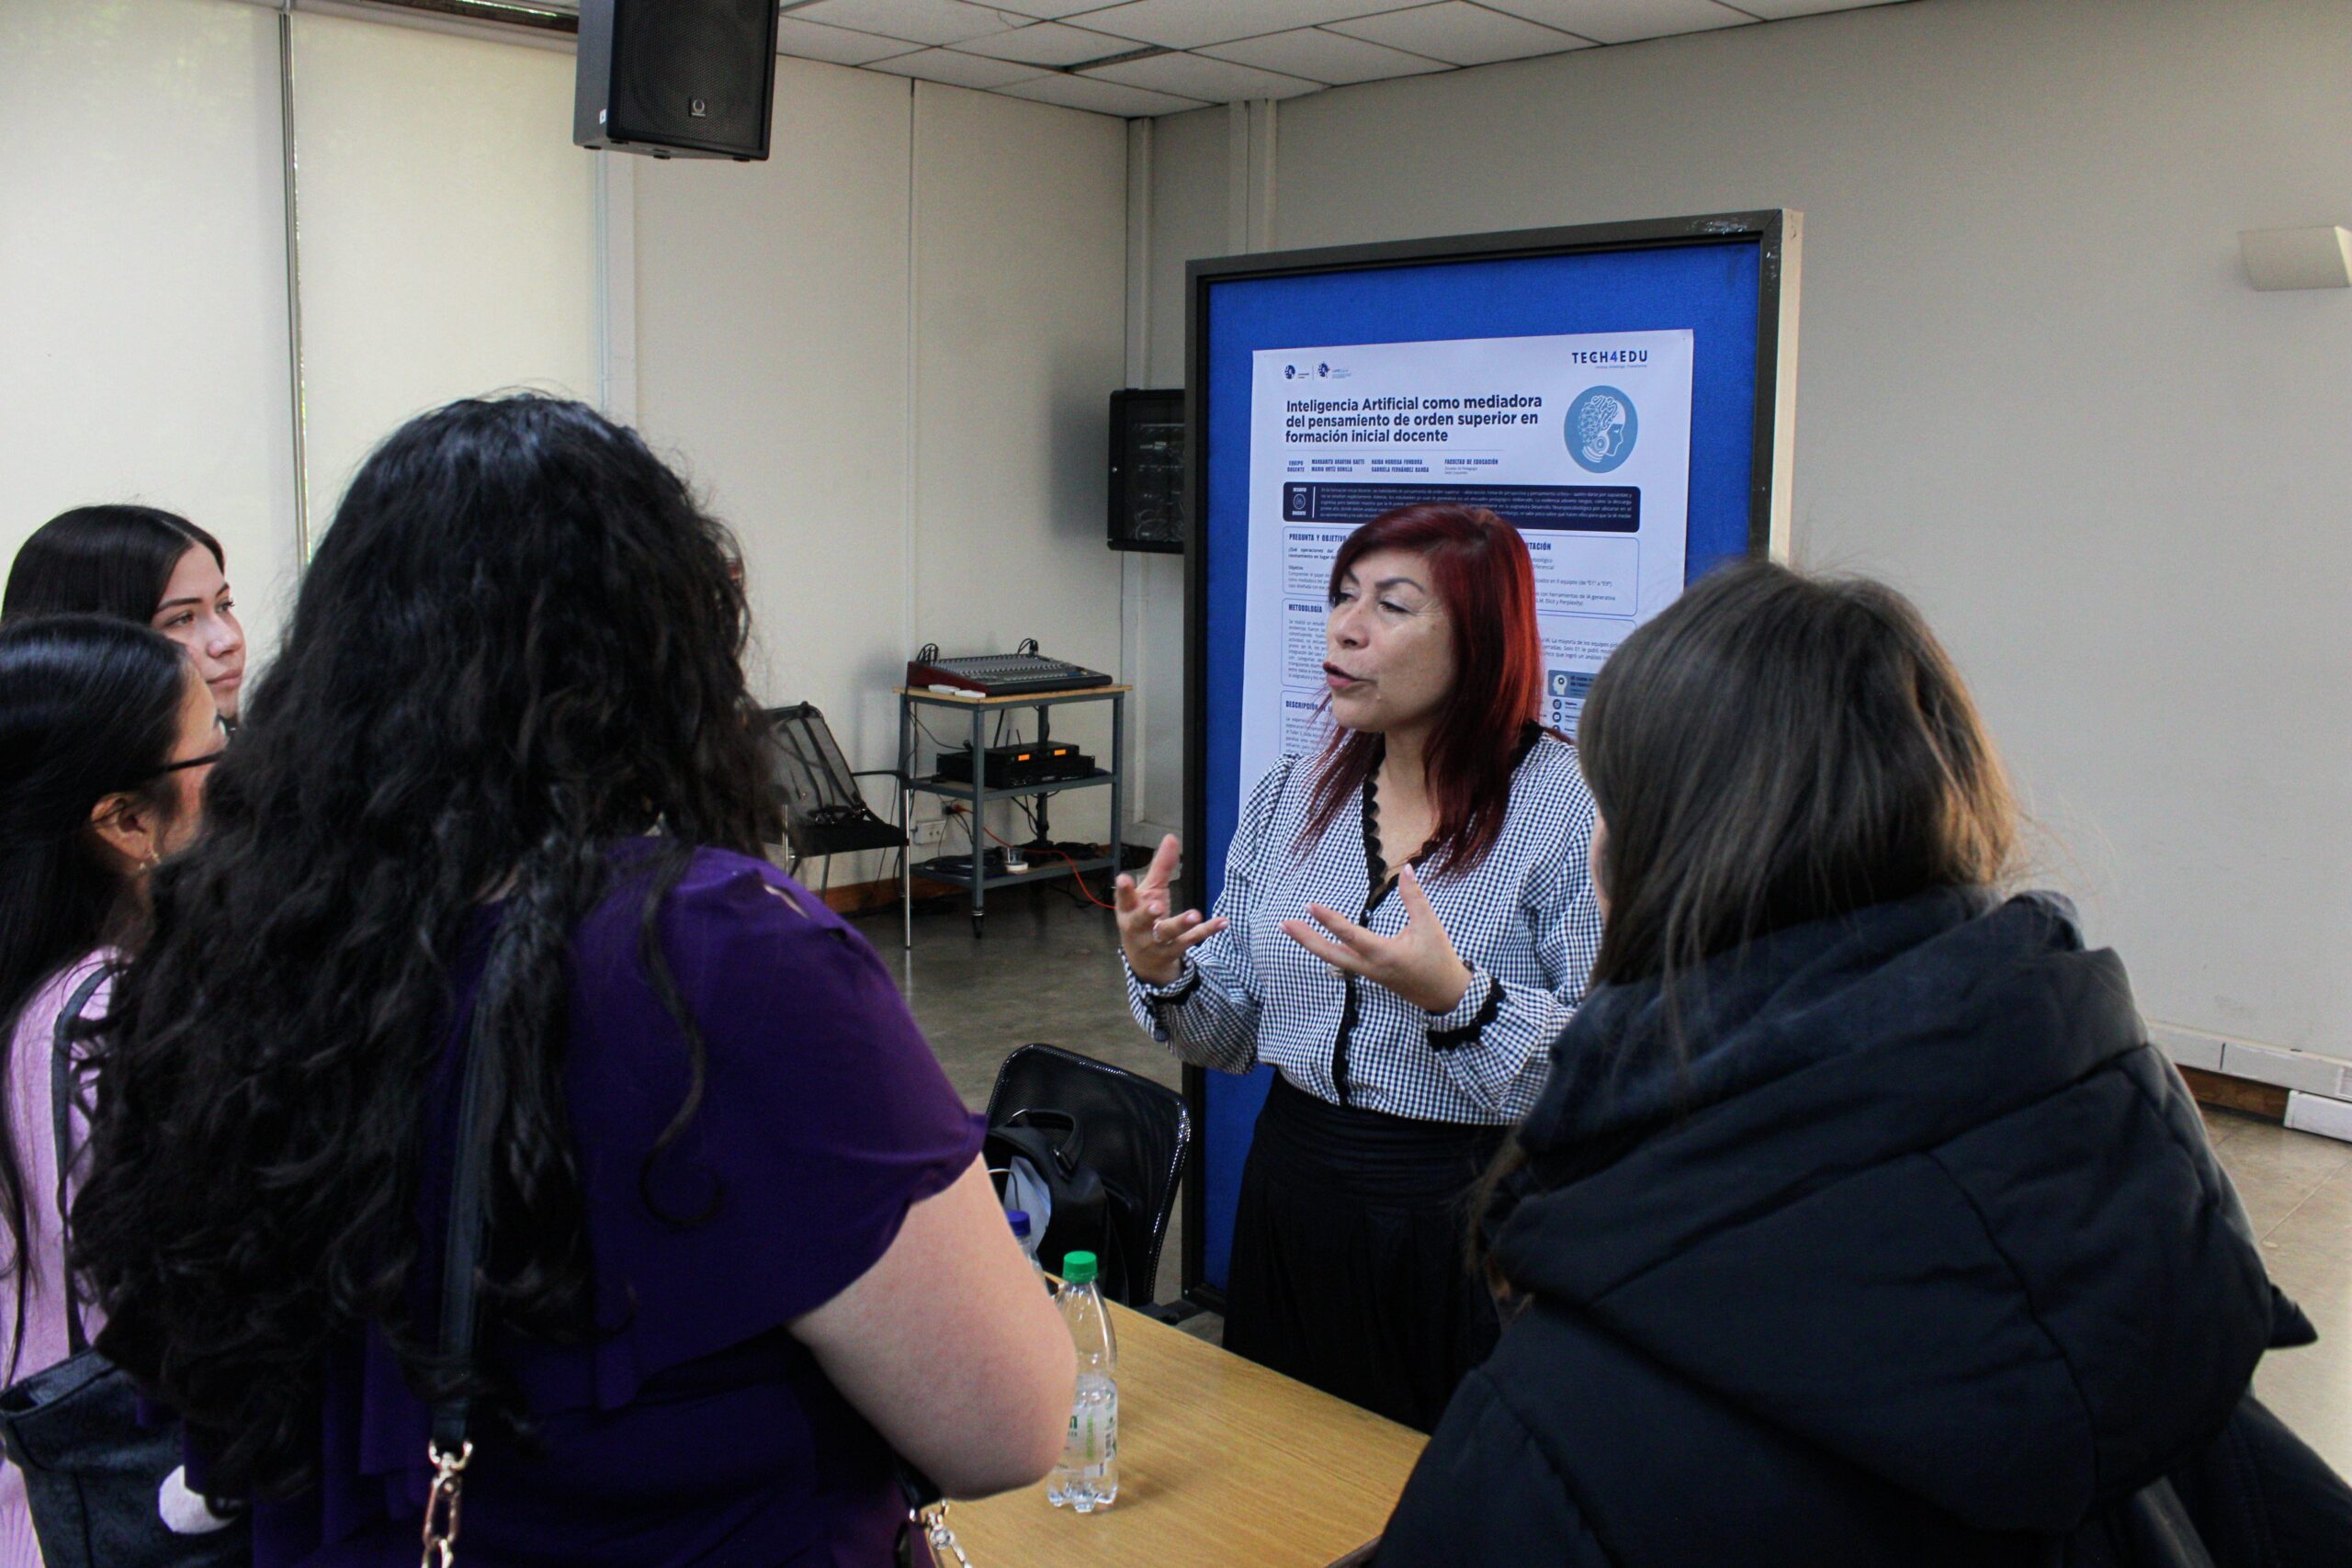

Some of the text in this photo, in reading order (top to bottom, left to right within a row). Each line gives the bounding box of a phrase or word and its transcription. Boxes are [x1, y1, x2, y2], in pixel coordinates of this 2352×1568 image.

[1572, 350, 1647, 364] TECH4EDU
[1286, 394, 1543, 412] Inteligencia Artificial como mediadora
[1286, 411, 1538, 429] del pensamiento de orden superior en
[1285, 429, 1448, 443] formación inicial docente
[1289, 604, 1322, 613] METODOLOGÍA
